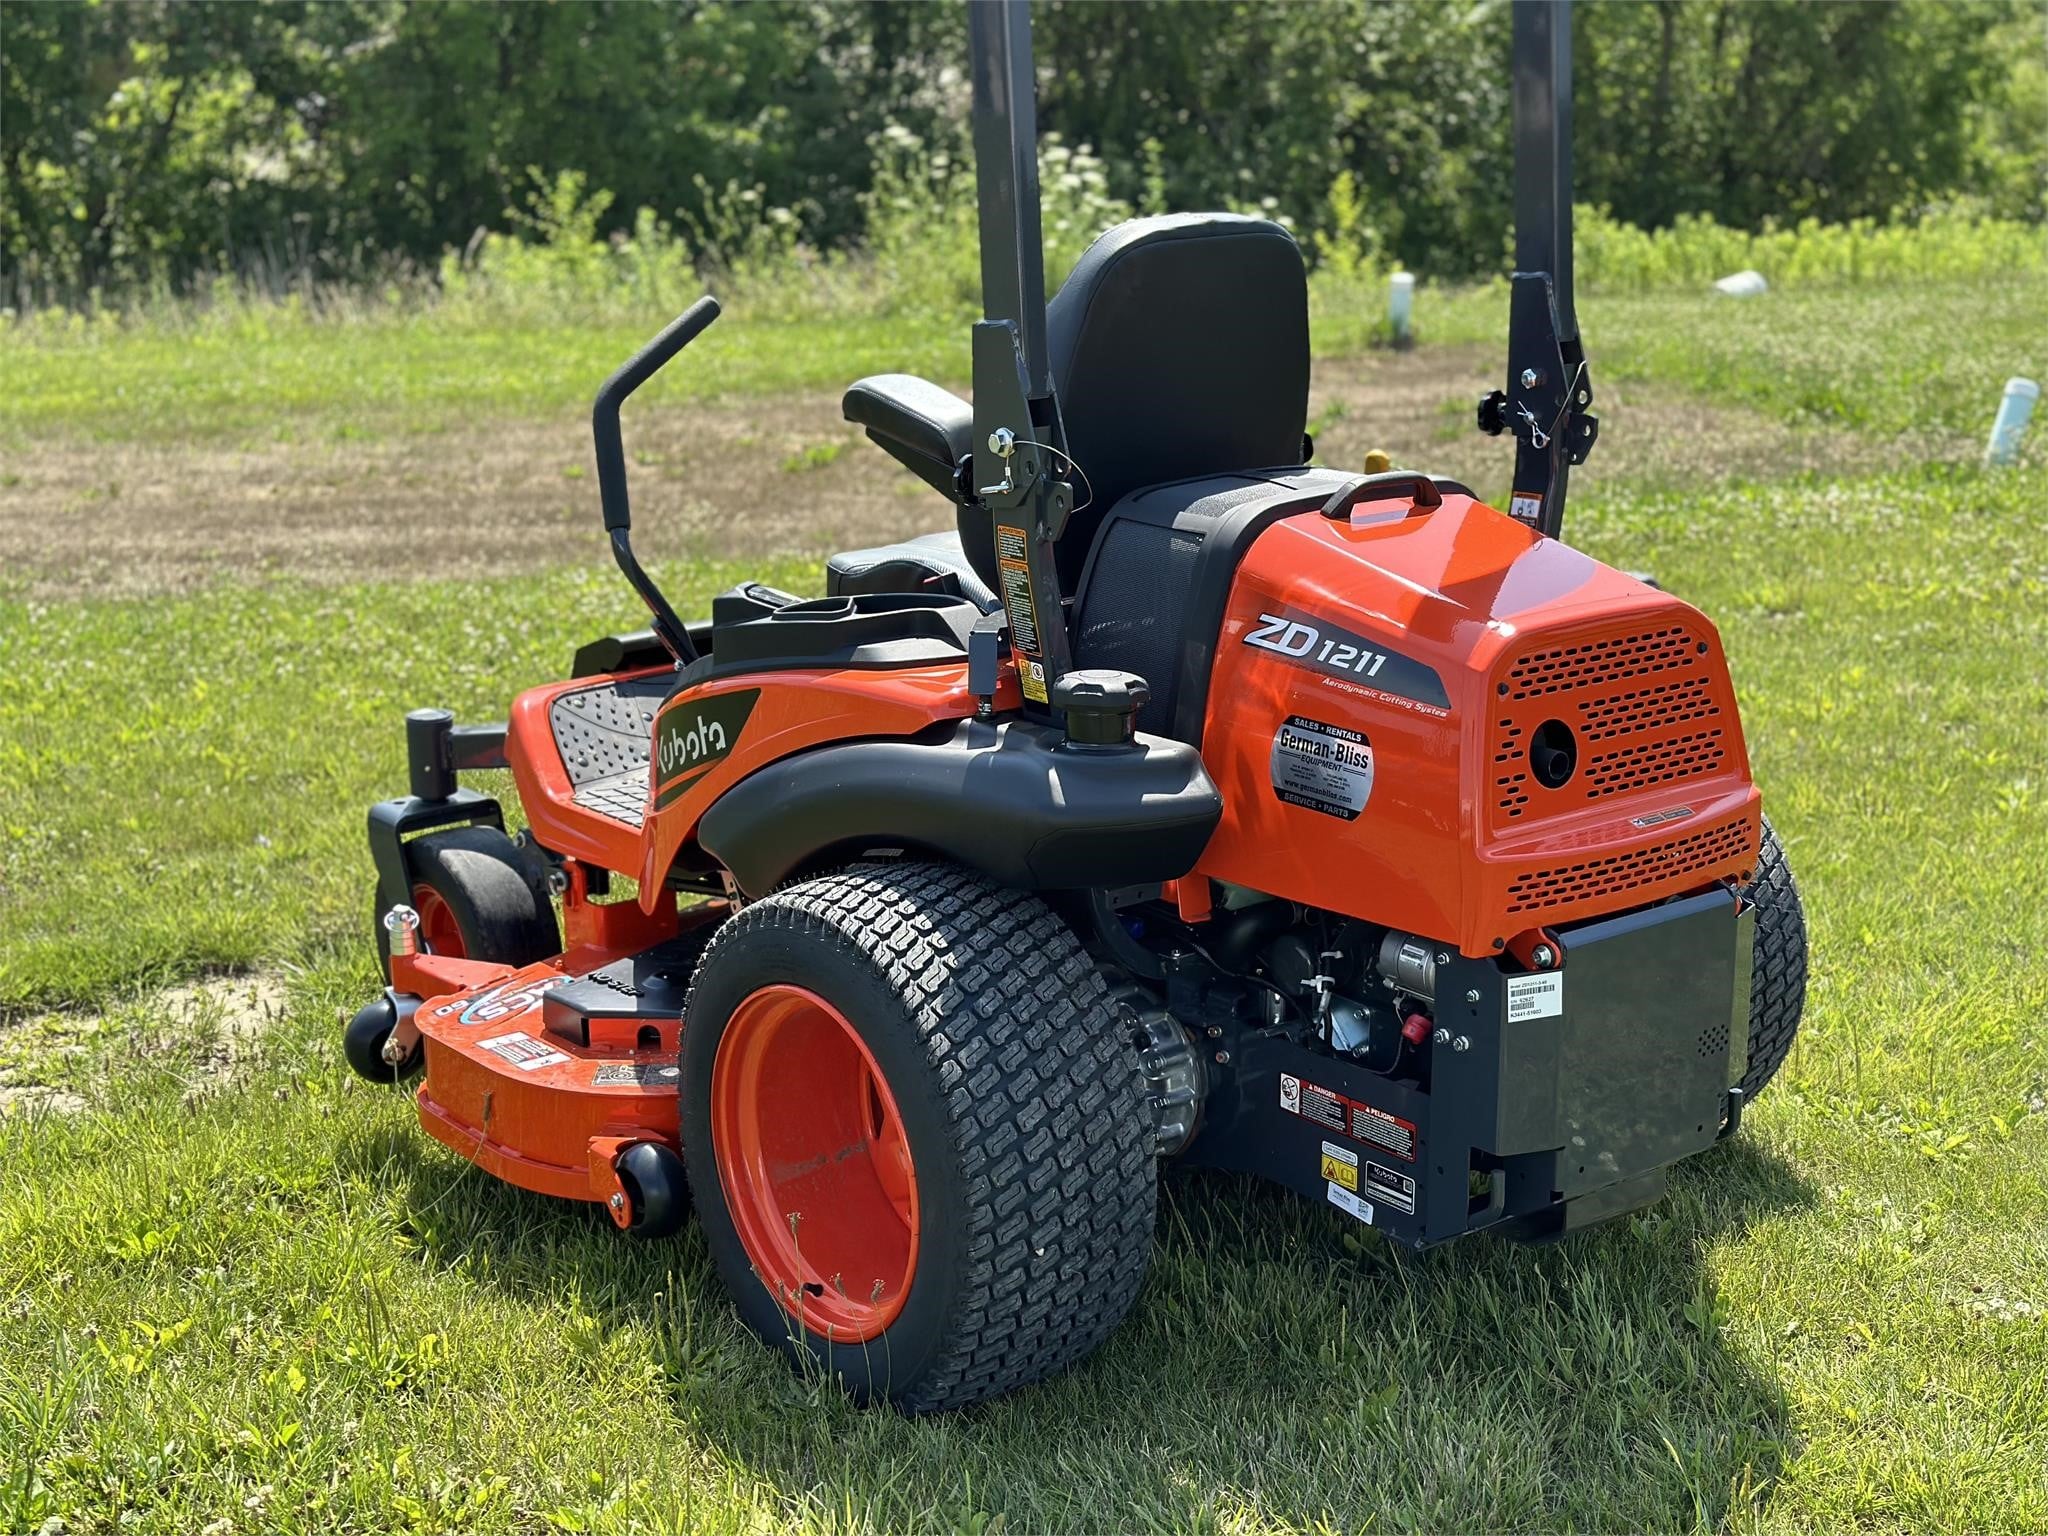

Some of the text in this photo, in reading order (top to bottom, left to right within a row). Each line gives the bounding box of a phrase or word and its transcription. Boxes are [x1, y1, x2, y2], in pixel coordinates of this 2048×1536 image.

[1317, 639, 1386, 677] 1211
[1322, 677, 1447, 718] Aerodynamic Cutting System
[1294, 718, 1362, 742] SALES RENTALS
[656, 715, 726, 774] Kubota
[1280, 728, 1369, 769] German-Bliss
[1301, 754, 1342, 772] EQUIPMENT
[1284, 780, 1352, 804] www.germanbliss.com
[1284, 792, 1349, 818] SERVICE PARTS
[1314, 1085, 1336, 1100] DANGER
[1371, 1107, 1395, 1123] PELIGRO
[1374, 1167, 1397, 1183] Kubota
